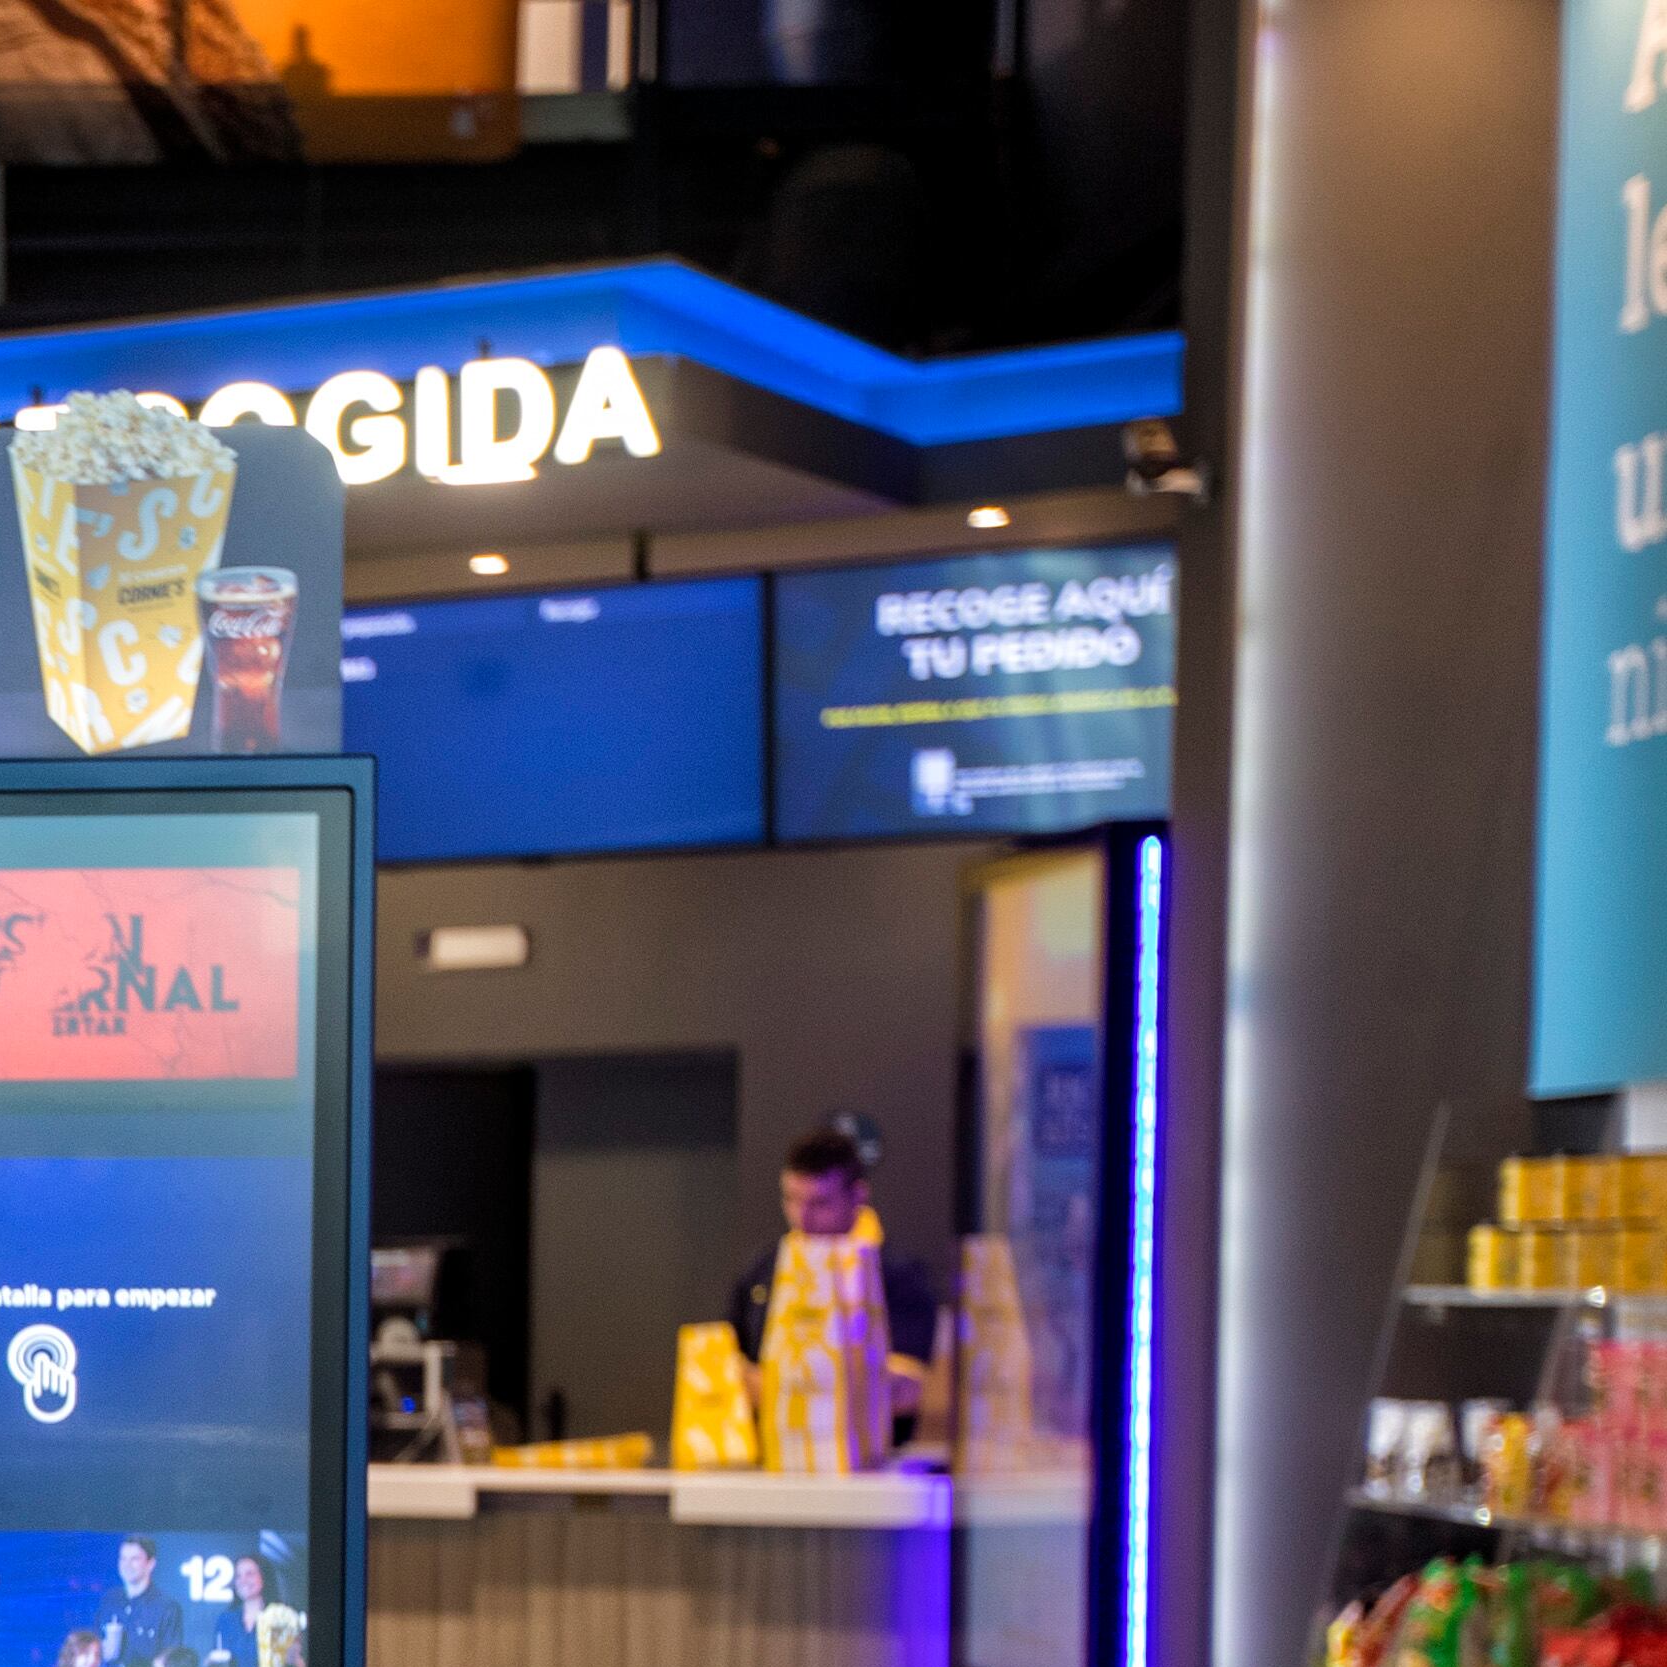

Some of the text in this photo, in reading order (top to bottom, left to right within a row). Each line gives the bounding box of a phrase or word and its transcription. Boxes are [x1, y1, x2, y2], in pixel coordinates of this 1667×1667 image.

[876, 563, 1175, 636] RECOGE AQUÍ
[901, 625, 1142, 681] TU PEDIDO
[56, 1288, 111, 1312] para
[114, 1288, 217, 1311] empezar
